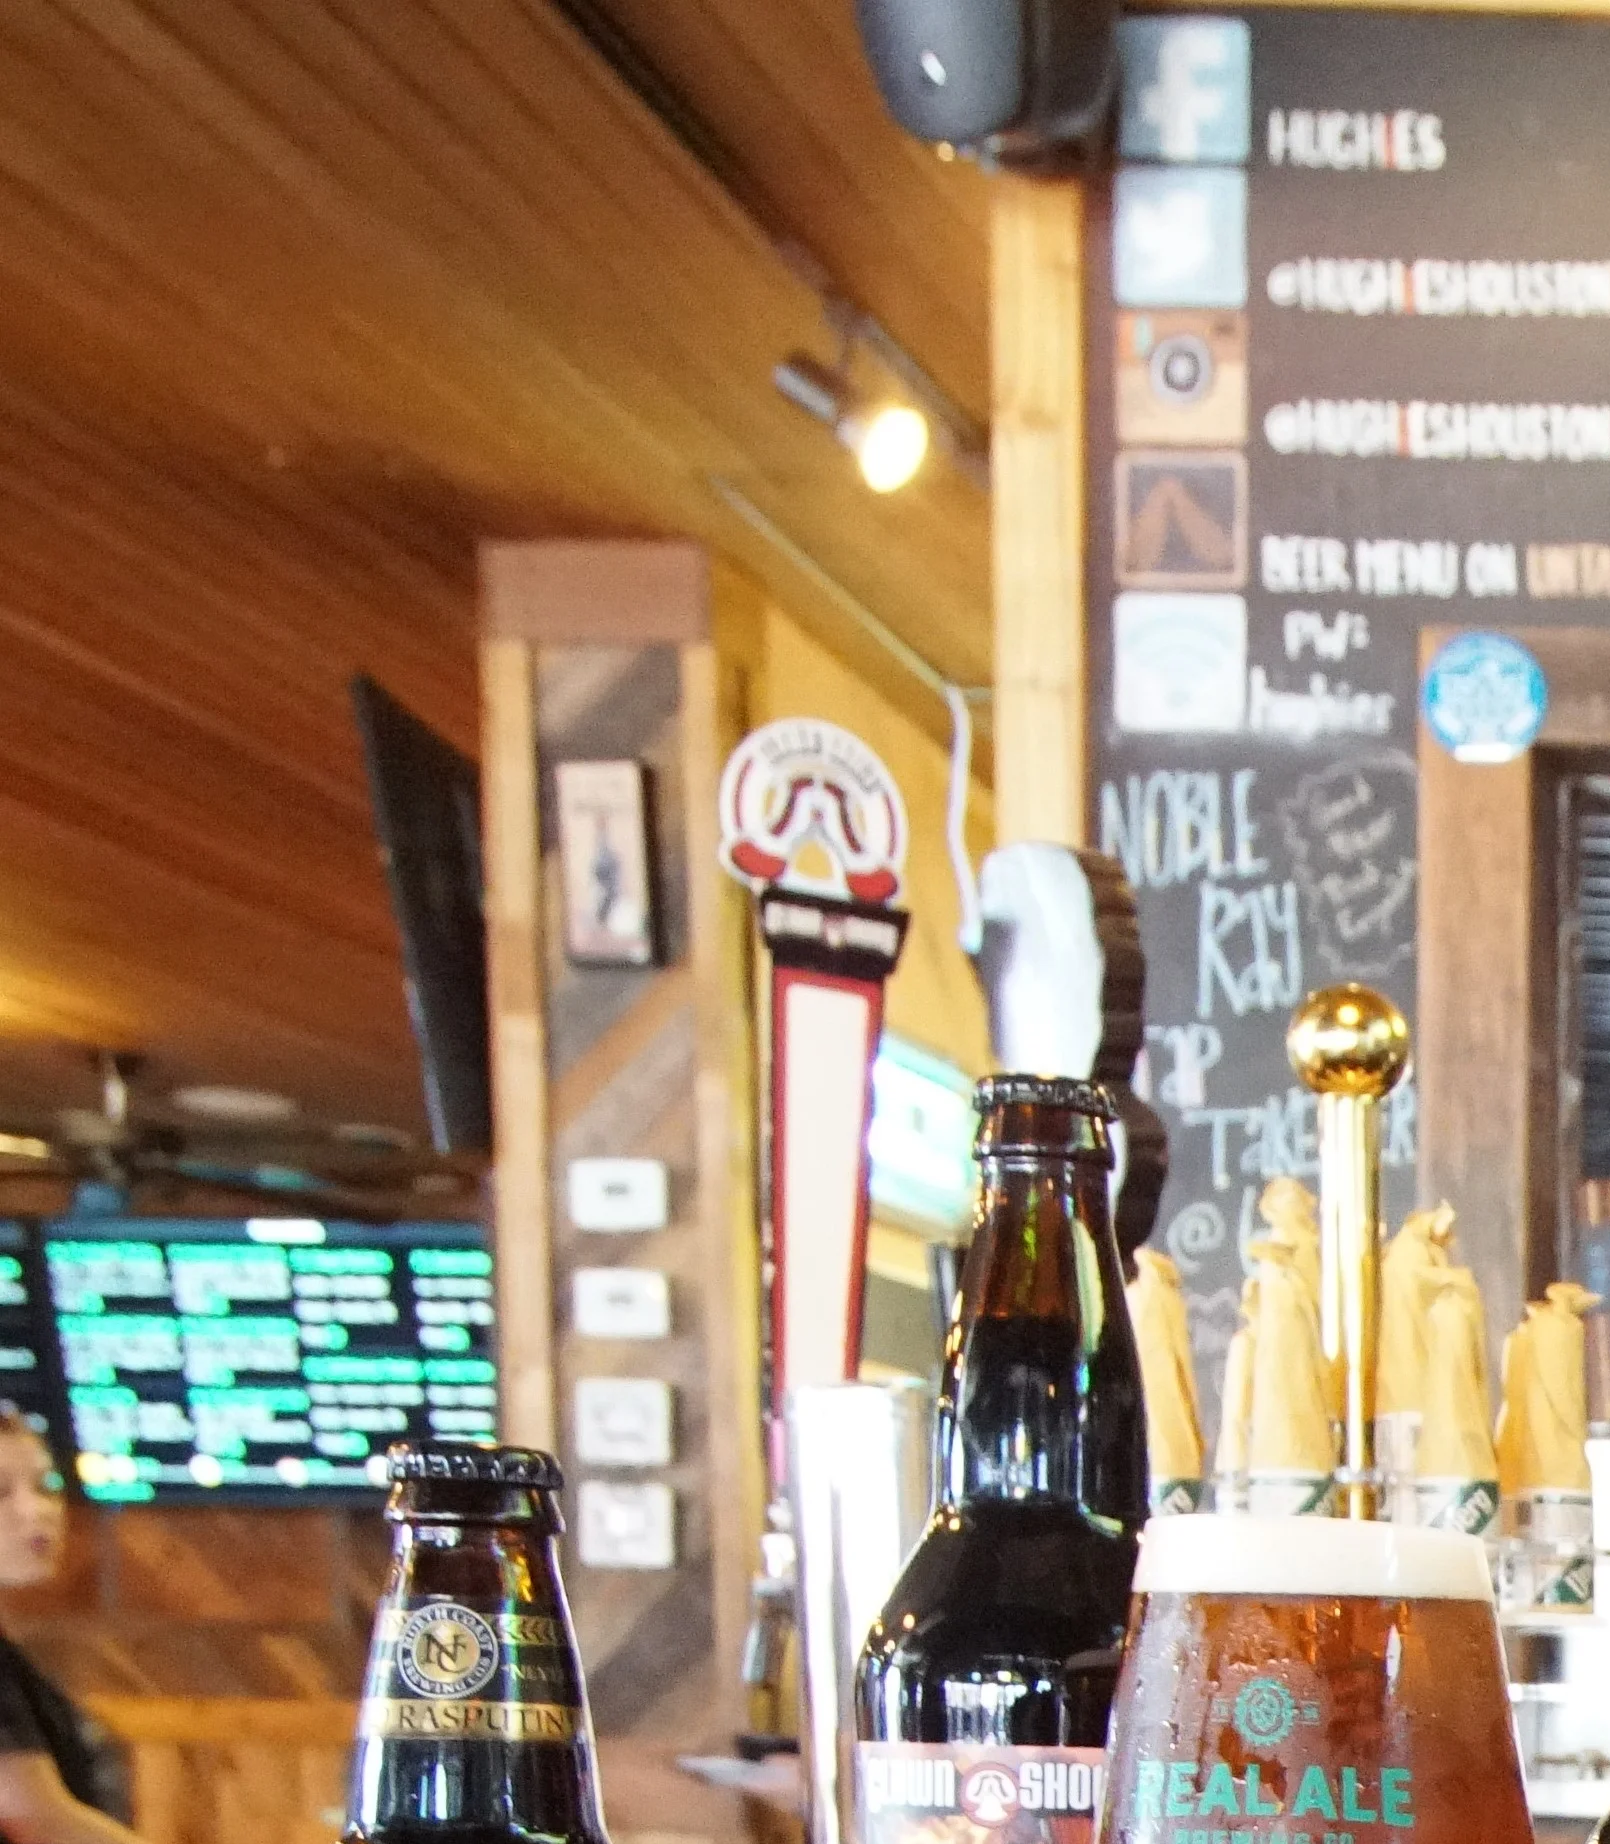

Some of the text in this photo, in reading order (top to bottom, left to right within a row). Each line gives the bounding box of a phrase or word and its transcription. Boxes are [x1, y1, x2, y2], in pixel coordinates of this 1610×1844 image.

[1262, 536, 1348, 592] BEER
[1356, 538, 1458, 598] MENU
[1466, 540, 1517, 597] ON
[1099, 768, 1269, 890] NOBLE
[400, 1705, 565, 1736] RASPUTIN
[1136, 1759, 1415, 1828] REAL ALE
